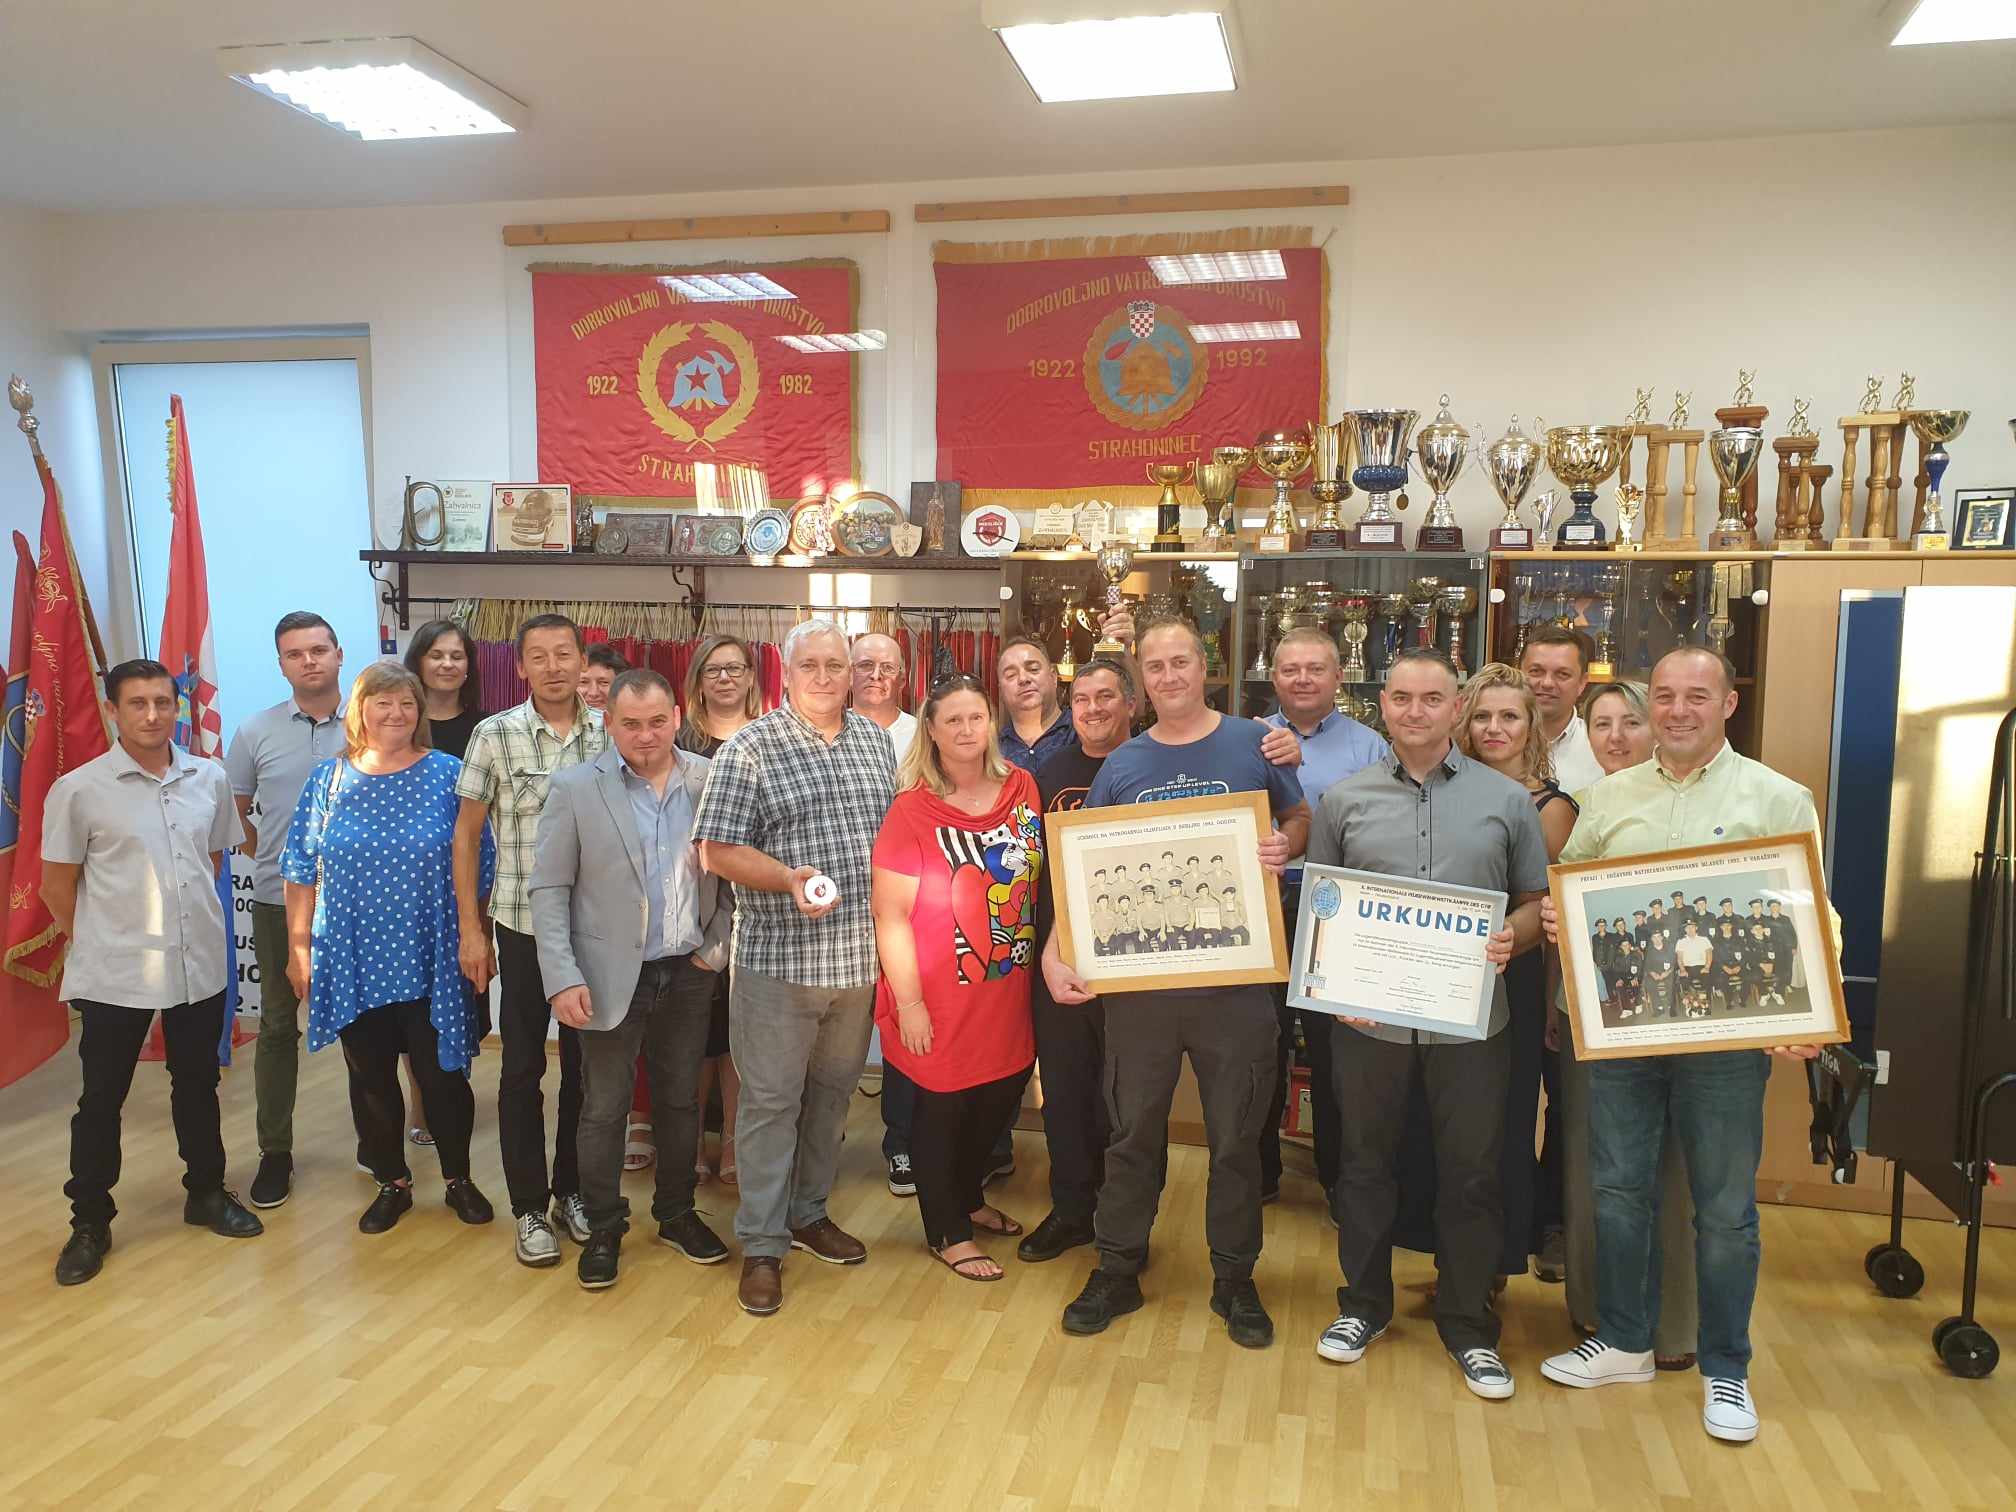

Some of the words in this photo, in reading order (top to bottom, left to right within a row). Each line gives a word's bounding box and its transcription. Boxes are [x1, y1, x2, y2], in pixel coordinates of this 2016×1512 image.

[571, 289, 660, 341] DOBROVOLJNO
[1007, 276, 1110, 336] DOBROVOLJNO
[1028, 359, 1076, 379] 1922
[1216, 348, 1267, 369] 1992
[587, 374, 619, 395] 1922
[779, 374, 813, 395] 1982
[1088, 433, 1202, 460] STRAHONINEC
[1358, 899, 1490, 937] URKUNDE
